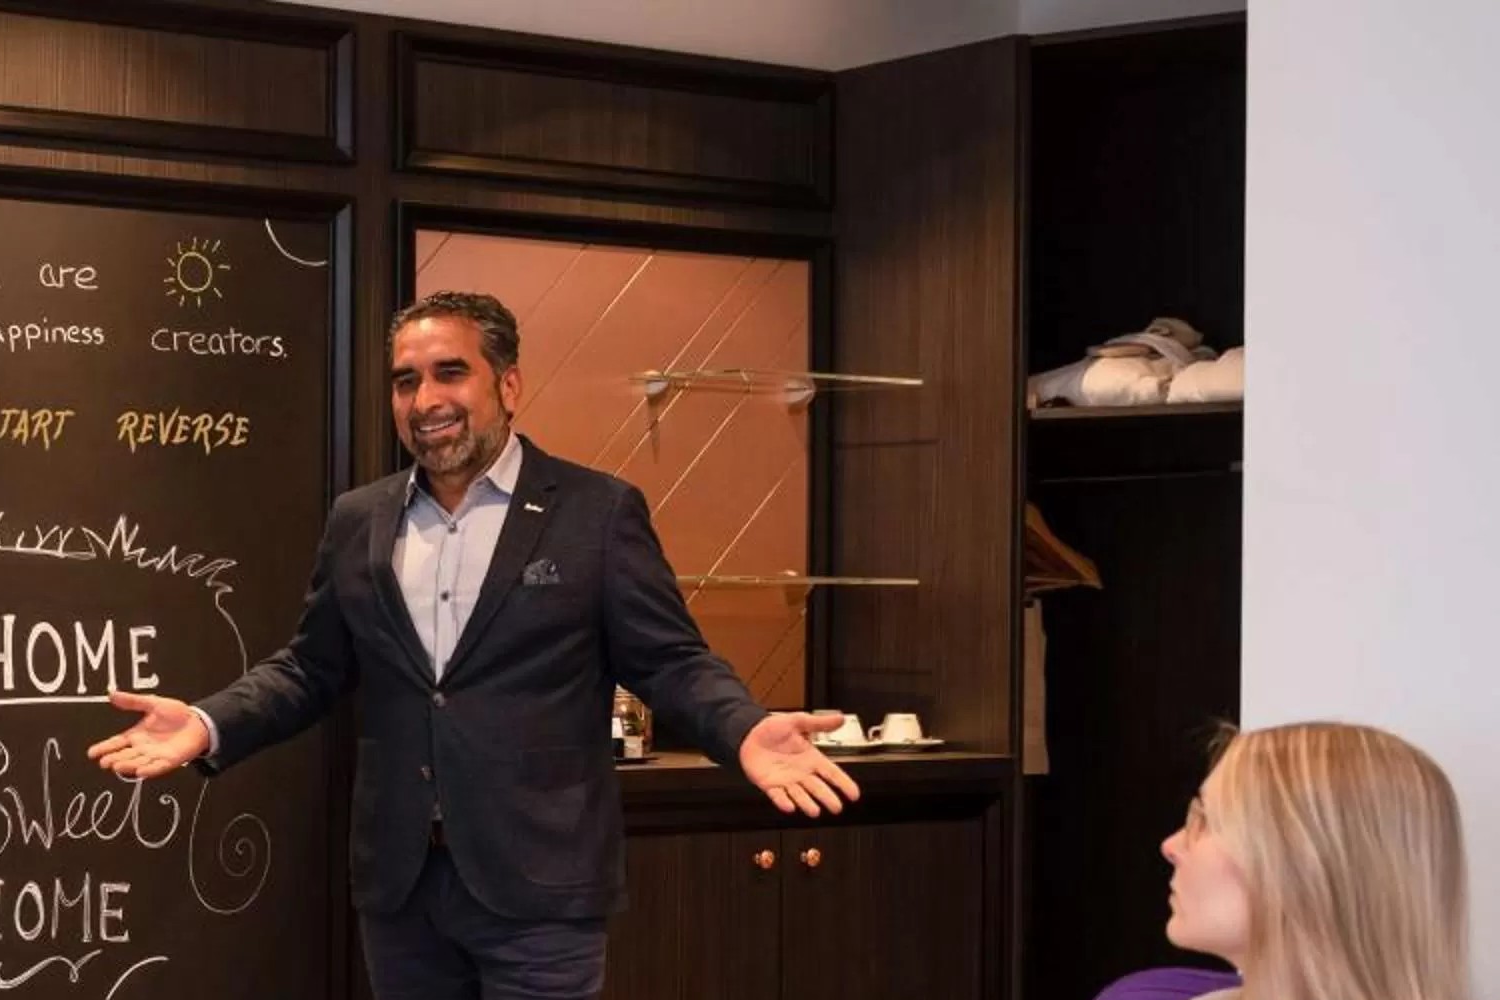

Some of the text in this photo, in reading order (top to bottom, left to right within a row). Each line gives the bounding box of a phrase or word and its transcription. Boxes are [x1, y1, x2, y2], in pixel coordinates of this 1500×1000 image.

[38, 260, 99, 291] are
[150, 326, 288, 358] creators.
[116, 406, 250, 455] REVERSE
